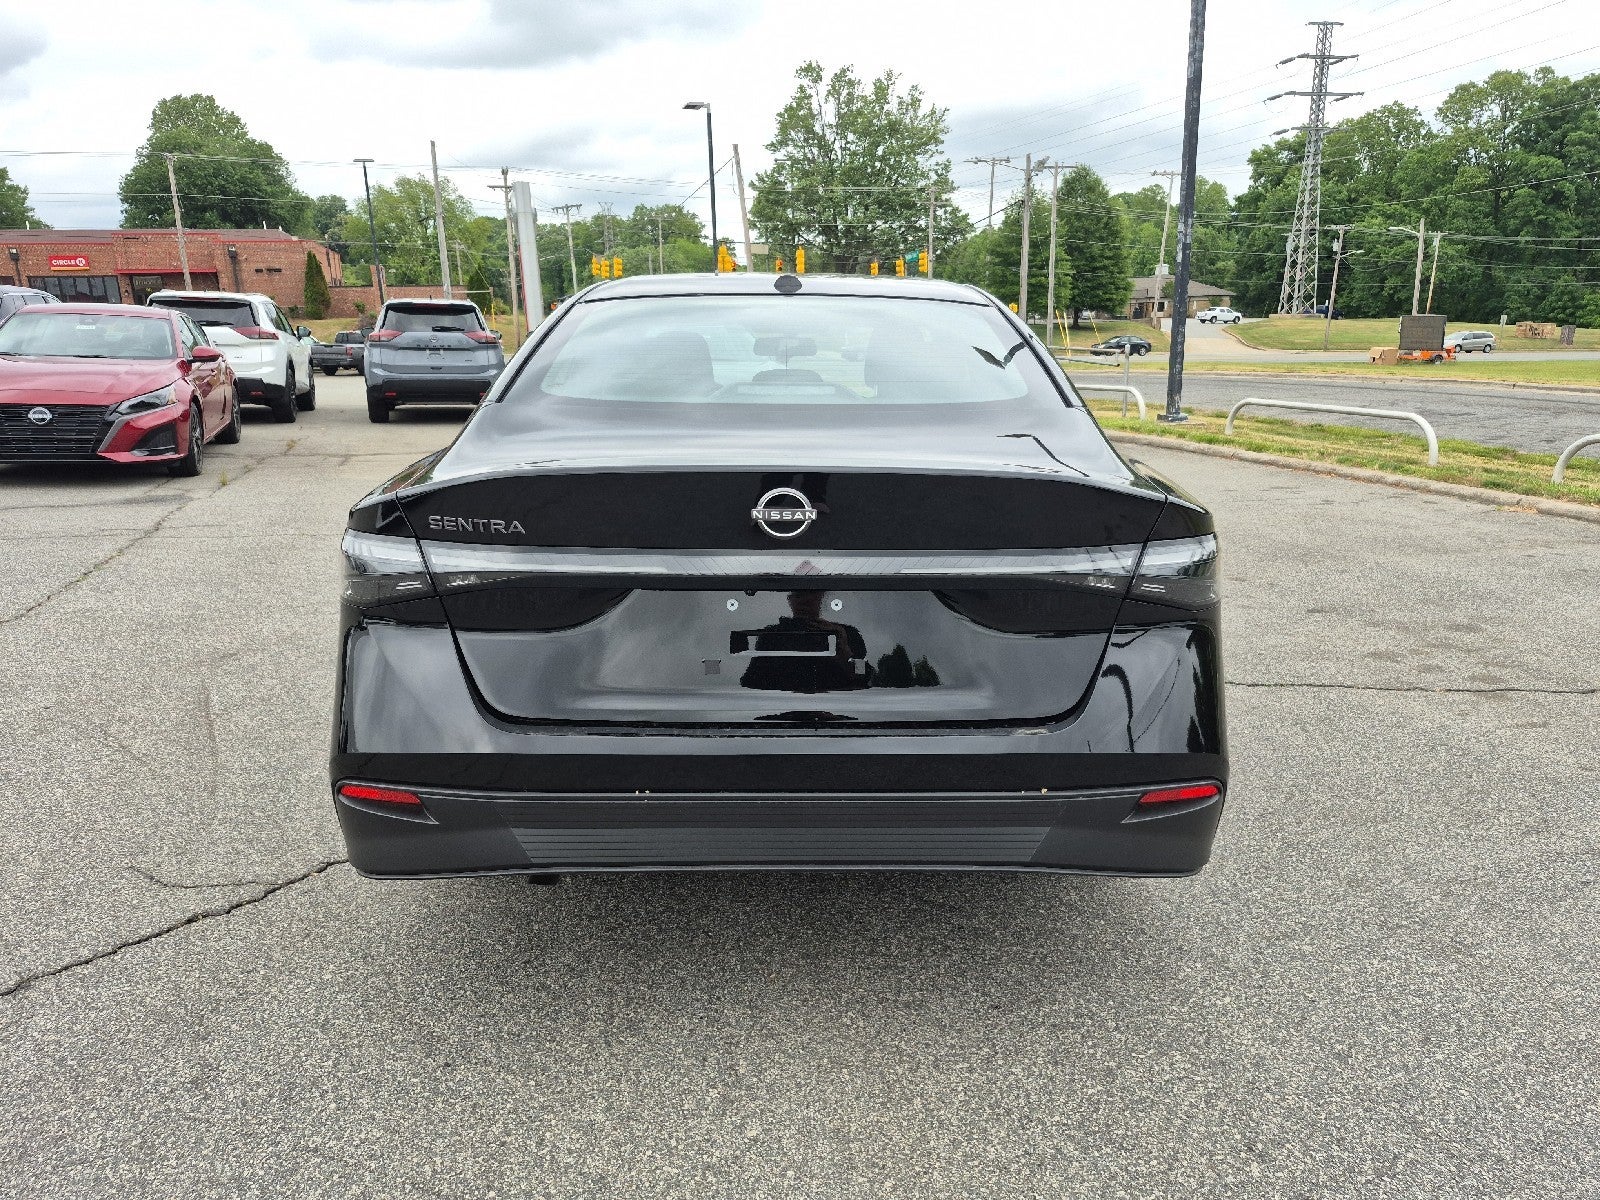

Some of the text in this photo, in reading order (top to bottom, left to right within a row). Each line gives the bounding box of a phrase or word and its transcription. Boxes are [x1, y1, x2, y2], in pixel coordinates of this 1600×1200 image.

[76, 258, 85, 266] K
[752, 510, 816, 520] NISSAN
[428, 515, 526, 534] SENTRA
